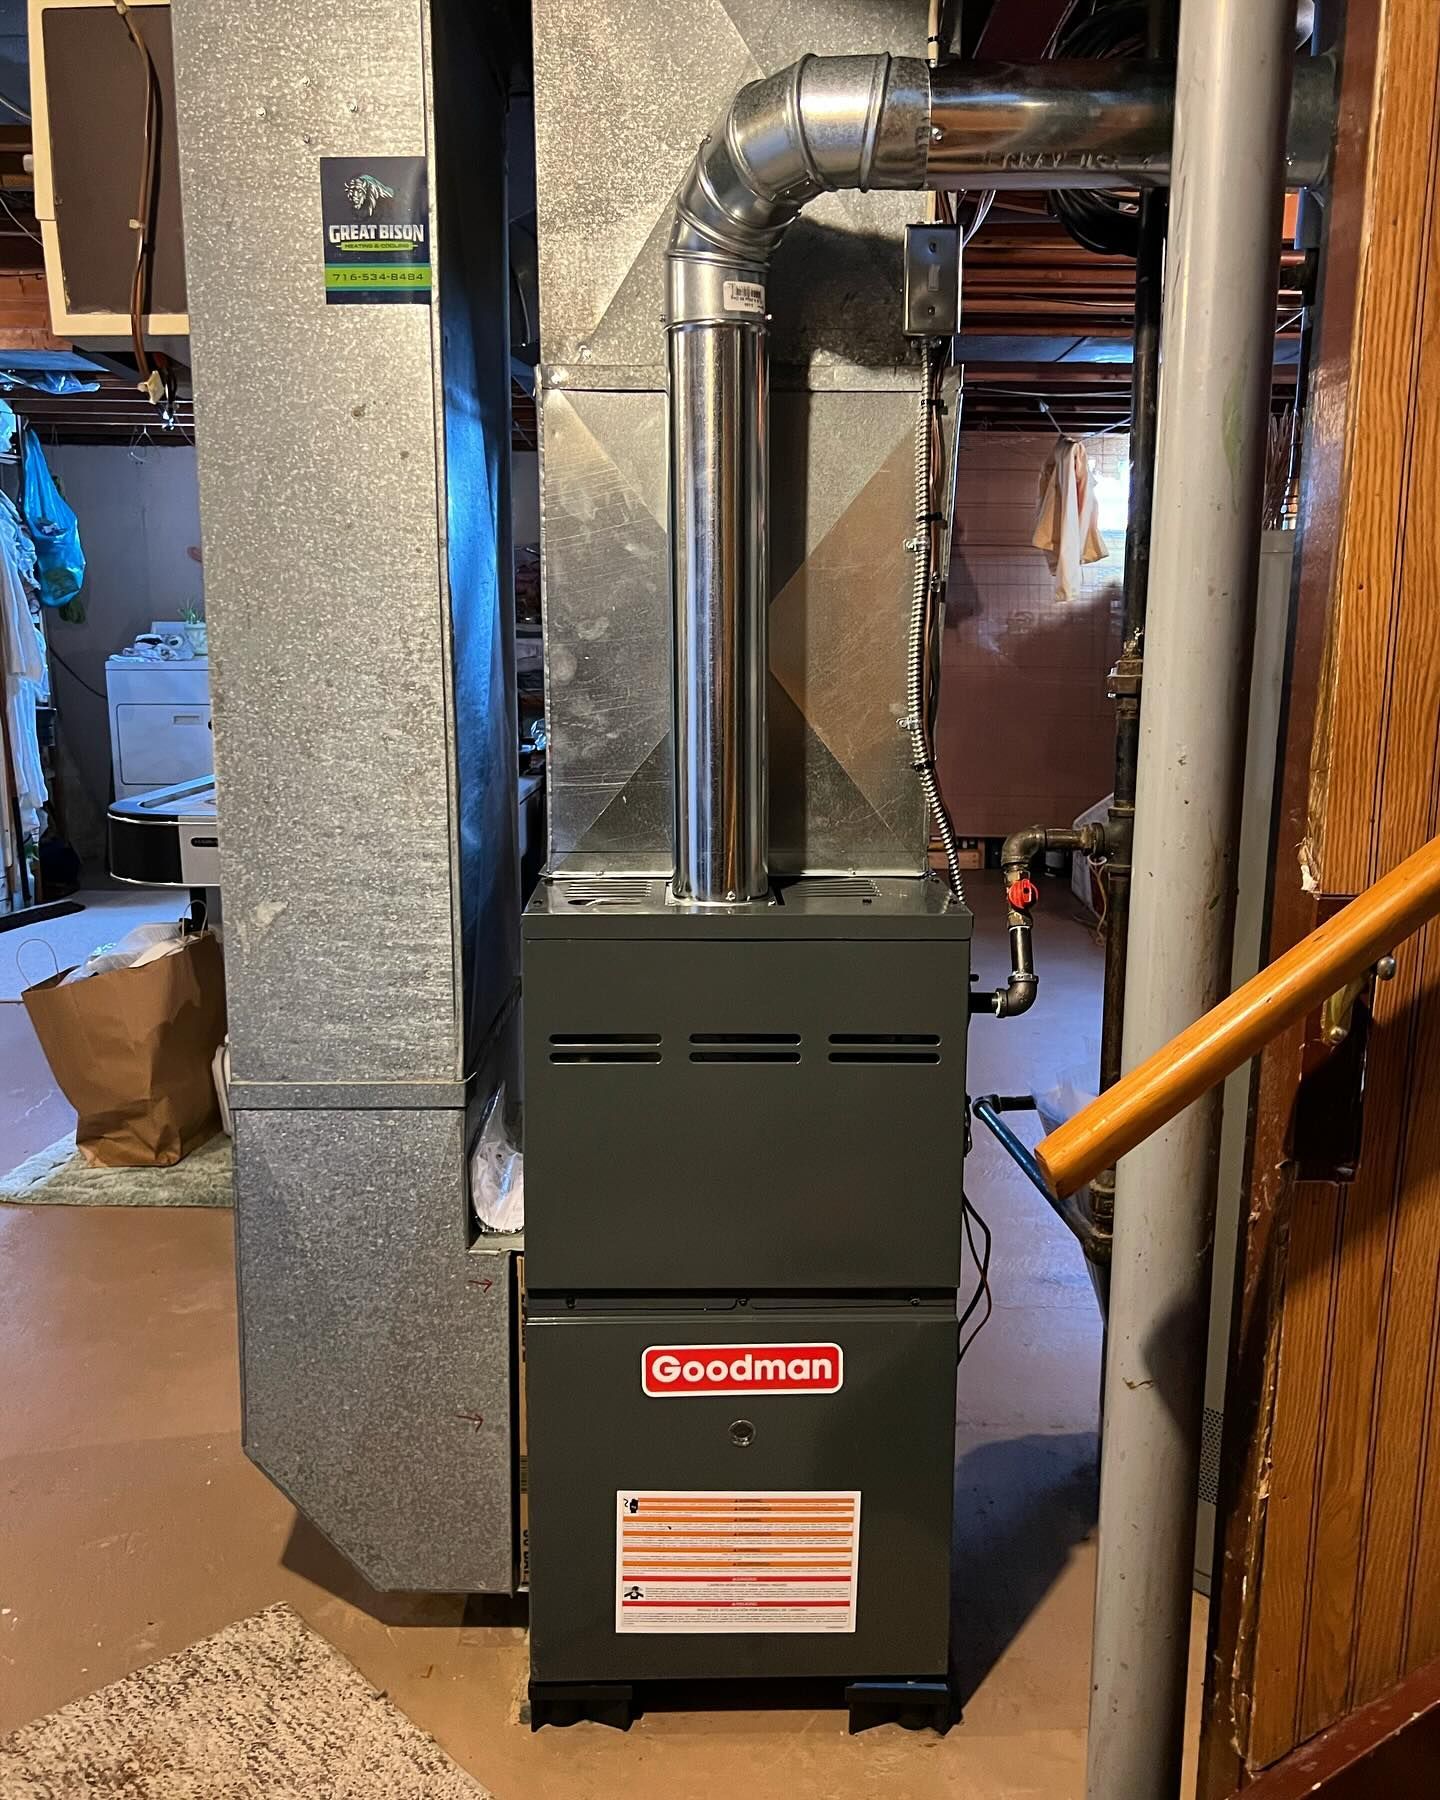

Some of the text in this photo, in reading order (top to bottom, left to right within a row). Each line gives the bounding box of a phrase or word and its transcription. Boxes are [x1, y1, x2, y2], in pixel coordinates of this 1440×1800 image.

[329, 224, 424, 243] GREAT BISON
[332, 273, 423, 281] 716-534-8484
[651, 1354, 833, 1383] Goodman
